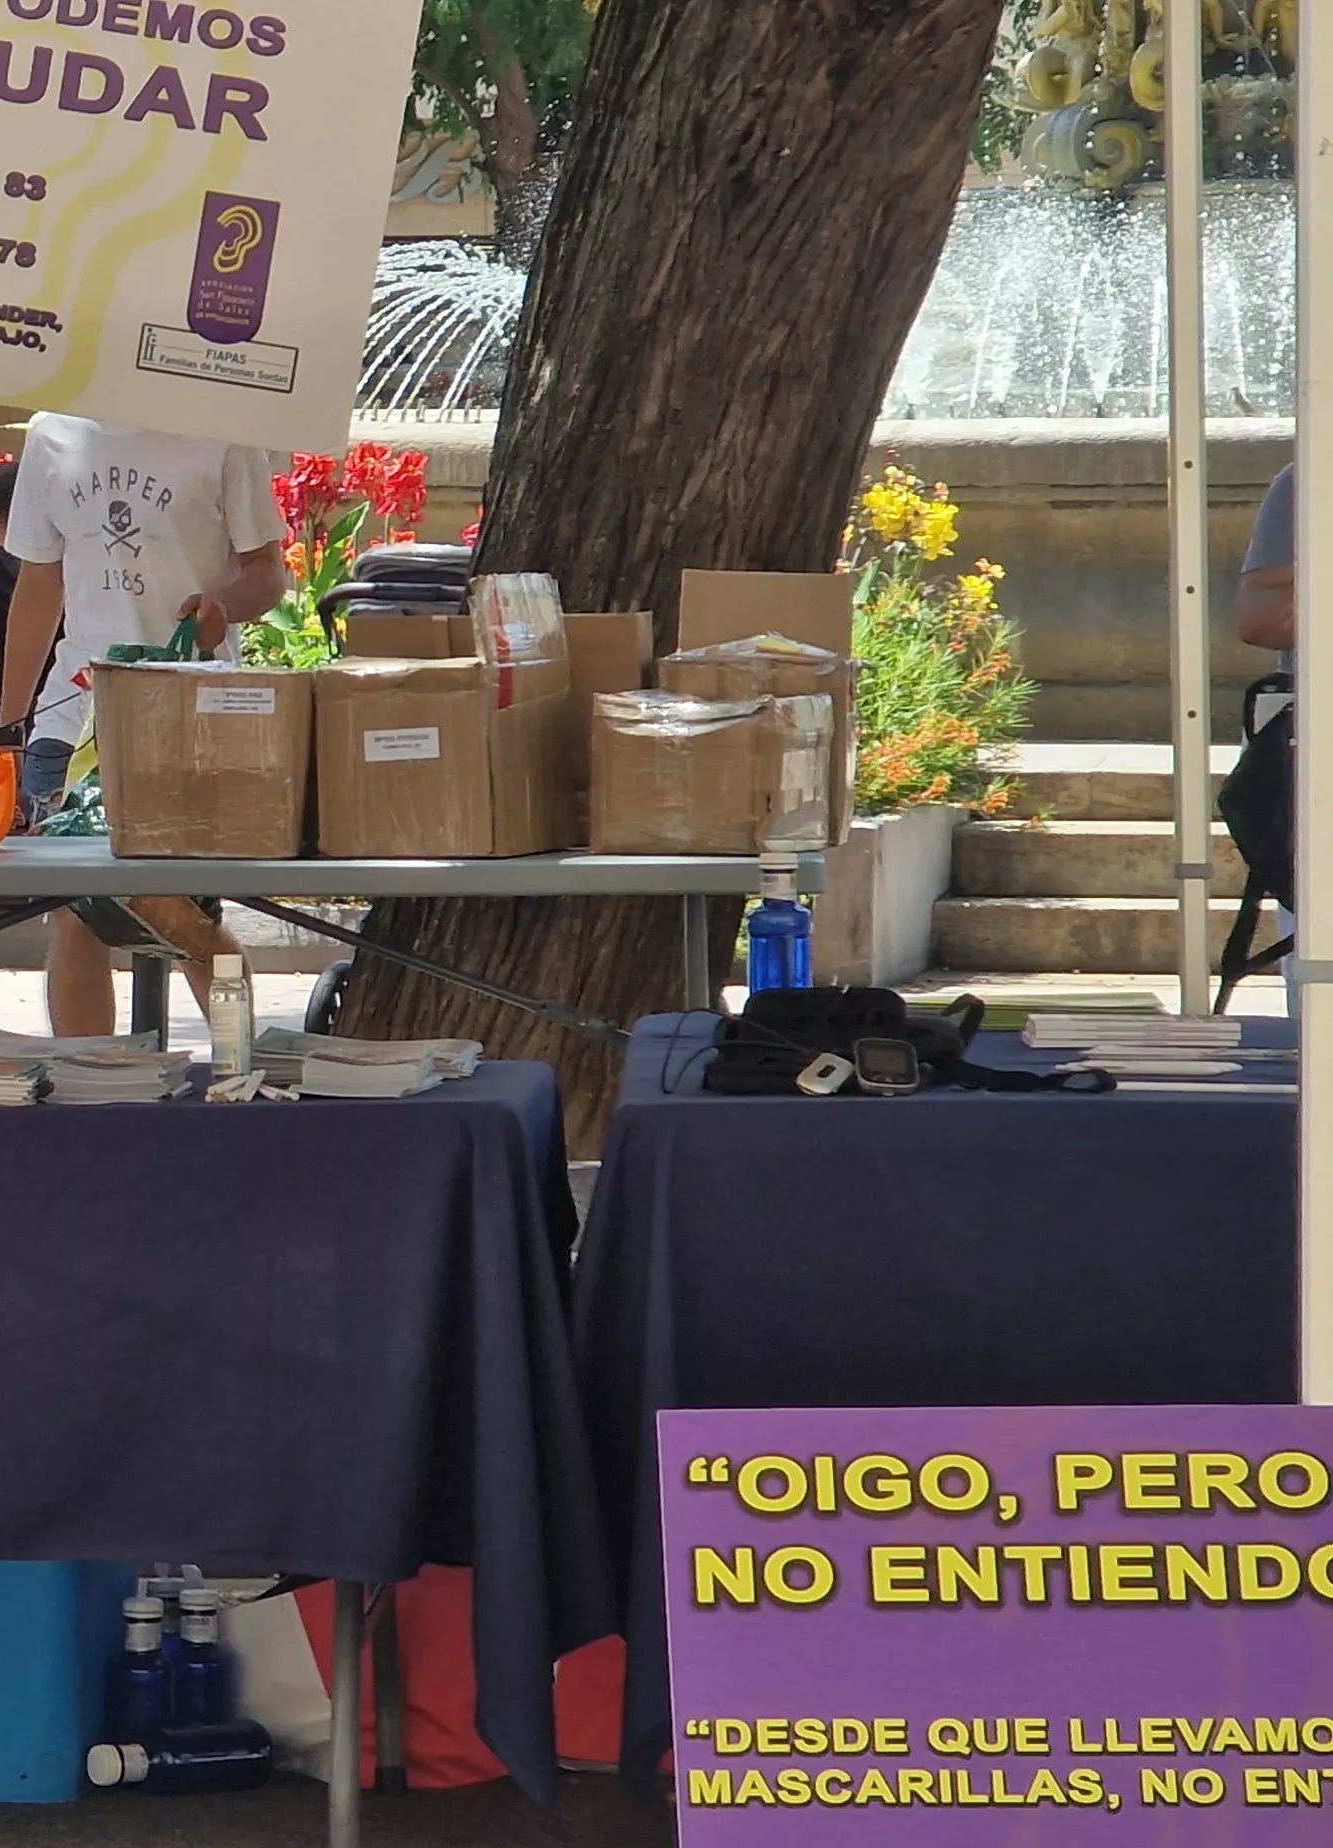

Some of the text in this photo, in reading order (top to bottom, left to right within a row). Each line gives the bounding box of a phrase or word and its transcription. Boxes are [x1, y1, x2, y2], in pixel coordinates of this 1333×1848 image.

[3, 171, 47, 201] 83
[159, 354, 288, 384] Familias de Personas Sordas
[205, 348, 247, 365] FIAPAS
[69, 465, 173, 513] HARPER
[1054, 1451, 1329, 1511] PERO
[693, 1546, 835, 1604] NO
[928, 1717, 1050, 1757] QUE
[1069, 1717, 1333, 1756] LLEVAMO
[690, 1769, 1333, 1812] MASCARILLAS, NO EN
